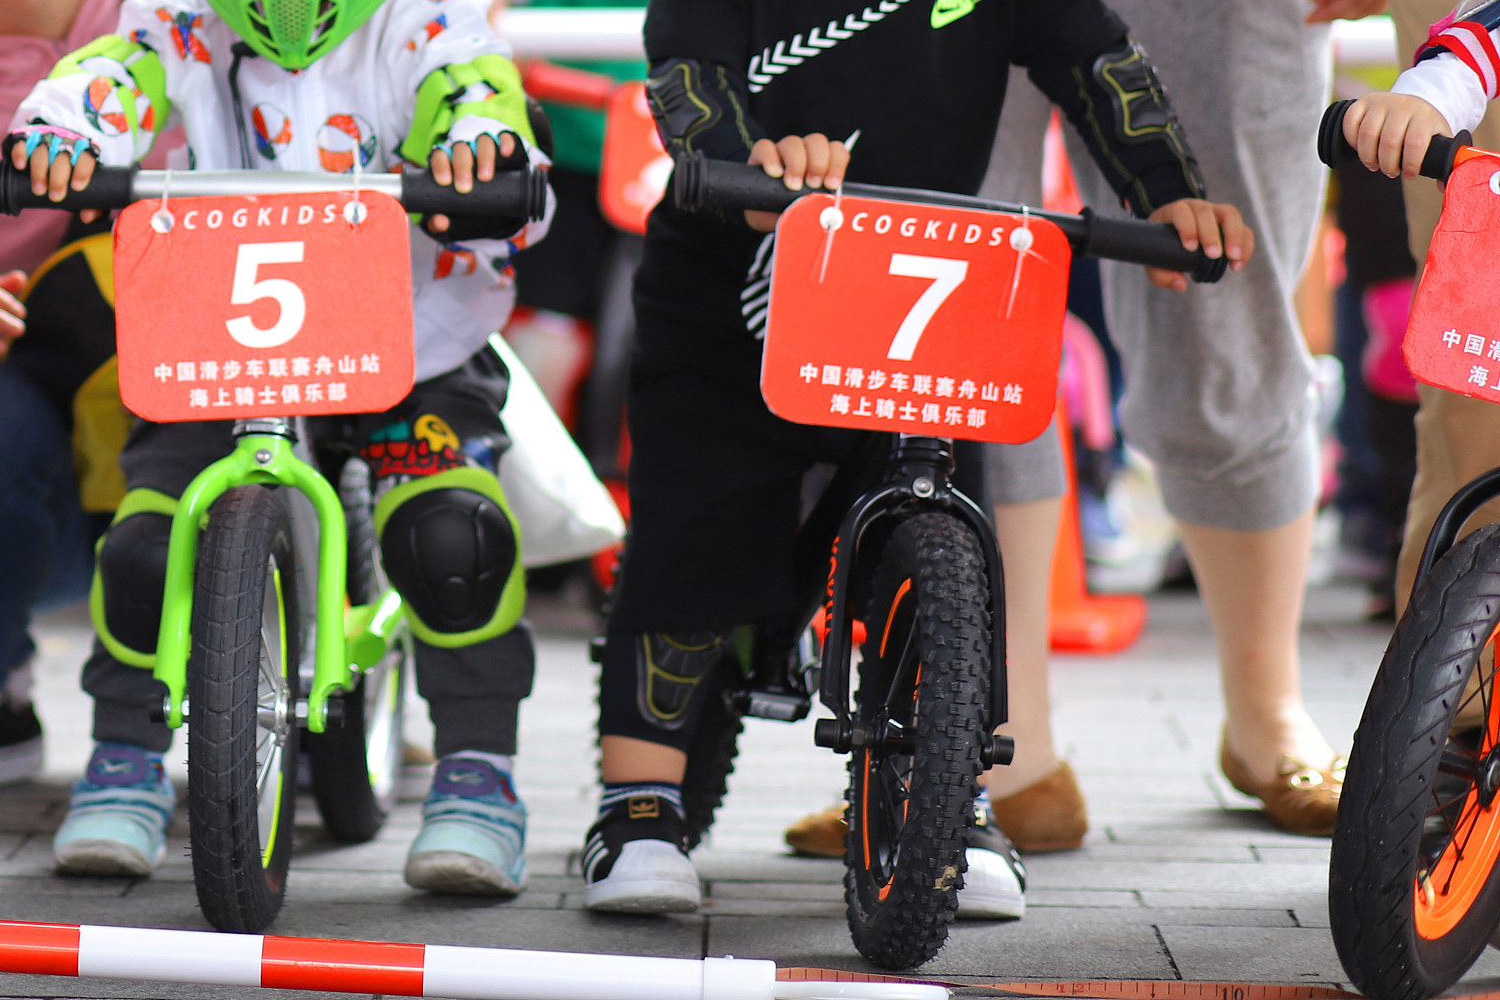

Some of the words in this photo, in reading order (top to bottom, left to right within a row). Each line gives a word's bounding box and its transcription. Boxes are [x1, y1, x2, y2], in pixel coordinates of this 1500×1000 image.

[183, 203, 337, 230] COGKIDS
[851, 212, 1004, 247] COGKIDS
[225, 240, 306, 349] 5
[886, 252, 969, 361] 7
[153, 353, 381, 384] 中国滑步车联赛舟山站
[799, 362, 1024, 405] 中国滑步车联赛舟山站
[189, 382, 348, 408] 海上骑士俱乐部
[829, 393, 987, 429] 海上骑士俱乐部
